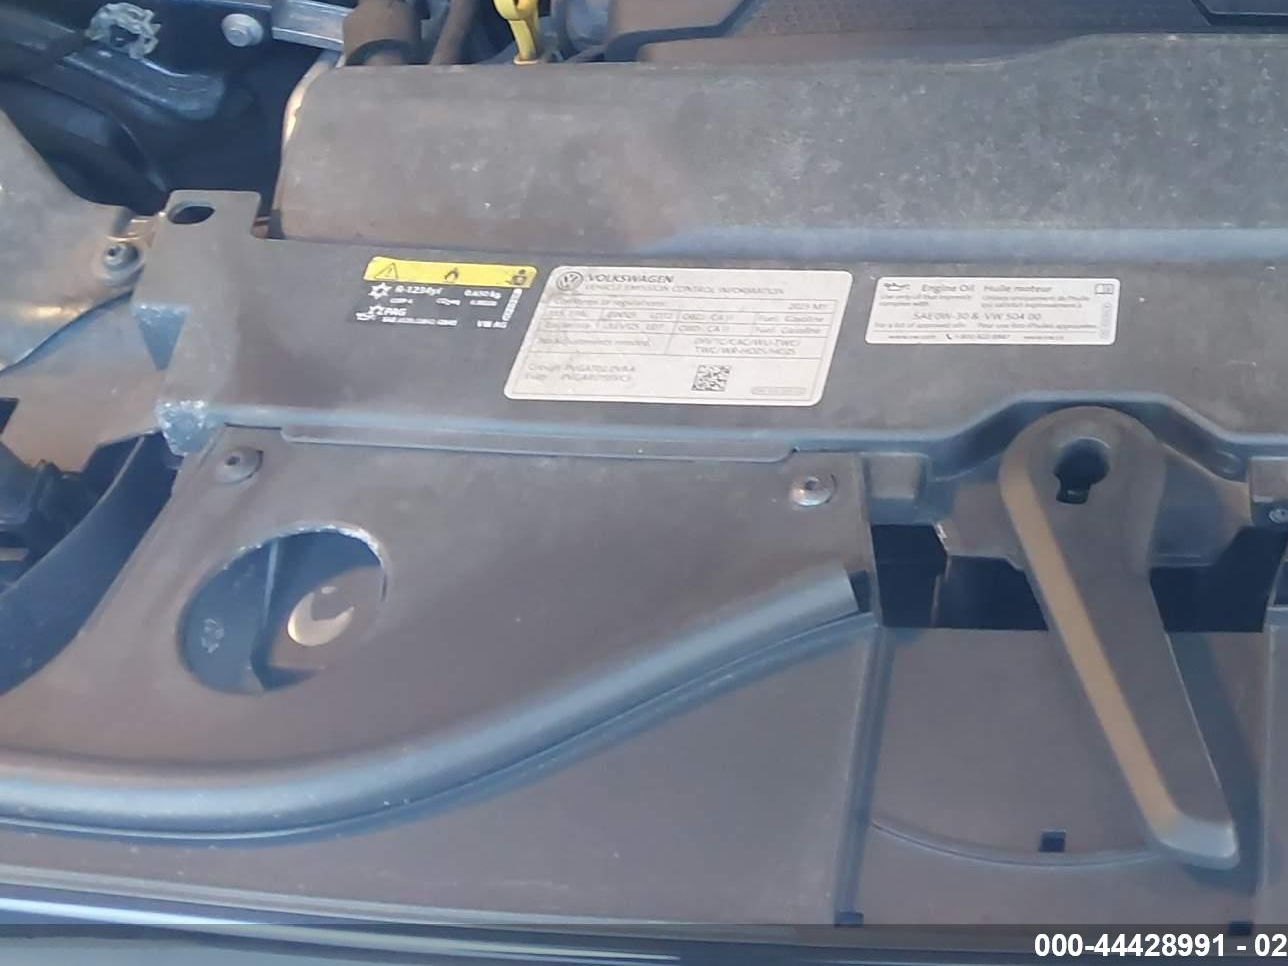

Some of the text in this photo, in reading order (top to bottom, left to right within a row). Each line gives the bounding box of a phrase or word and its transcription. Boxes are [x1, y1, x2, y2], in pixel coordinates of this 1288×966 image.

[586, 273, 675, 284] VOLKSWAGEN
[671, 285, 715, 293] CONTROL
[921, 283, 975, 294] Engine Oil
